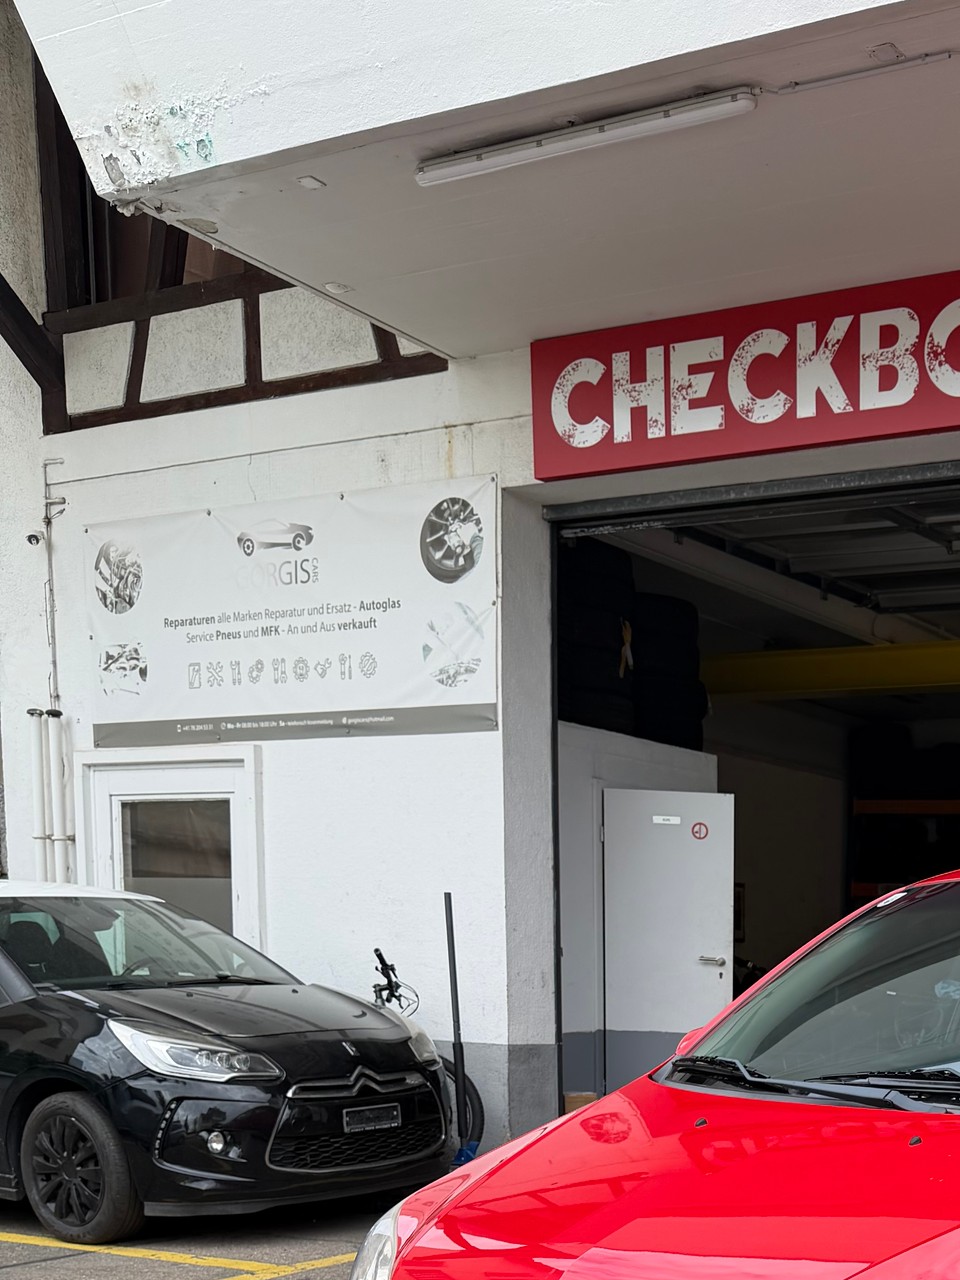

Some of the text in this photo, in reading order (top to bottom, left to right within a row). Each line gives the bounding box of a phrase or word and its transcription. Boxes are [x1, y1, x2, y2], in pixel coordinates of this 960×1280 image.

[311, 557, 319, 584] CARS
[164, 615, 216, 630] Reparaturen
[217, 612, 231, 624] alle
[233, 610, 263, 623] Marken
[264, 607, 305, 621] Reparatur
[307, 604, 324, 616] und
[326, 602, 352, 615] Ersatz
[359, 597, 401, 612] Autoglas
[186, 631, 214, 644] Service
[216, 630, 241, 641] Pneus
[243, 627, 259, 639] und
[261, 625, 280, 637] MFK
[287, 624, 298, 635] An
[300, 622, 317, 634] und
[319, 621, 335, 633] Aus
[337, 617, 377, 631] verkauft
